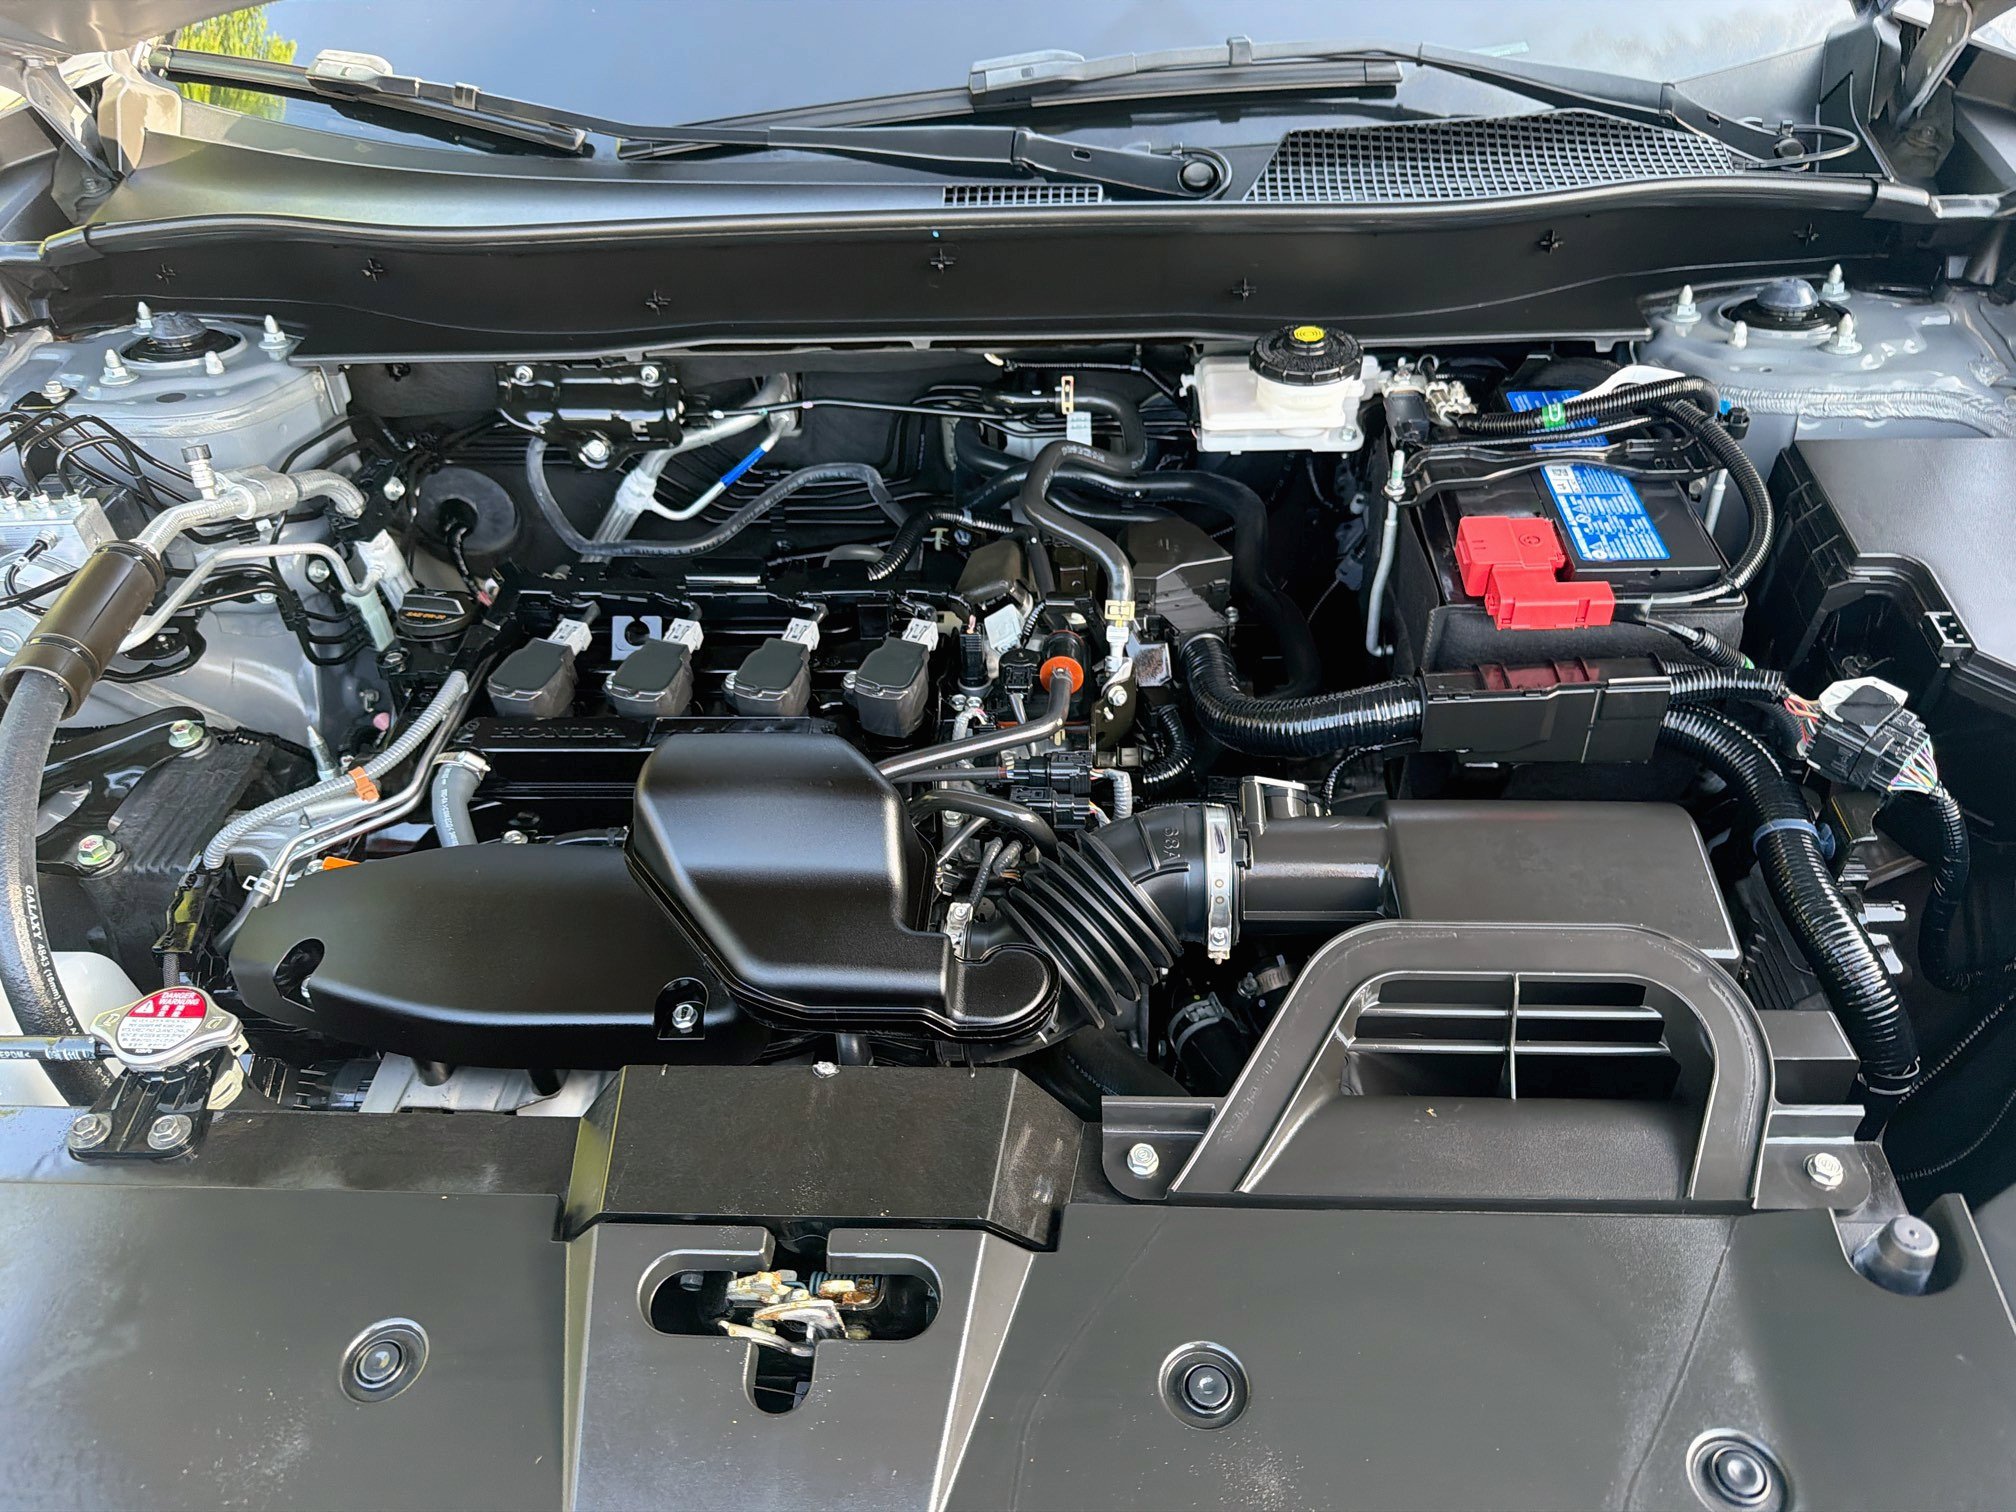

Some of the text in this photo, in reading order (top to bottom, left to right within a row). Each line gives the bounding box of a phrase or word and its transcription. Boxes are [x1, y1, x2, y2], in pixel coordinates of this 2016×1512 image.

[490, 727, 627, 739] HONDA
[25, 885, 43, 940] GALAXY
[37, 943, 51, 967] 4843
[158, 998, 201, 1006] WARNING
